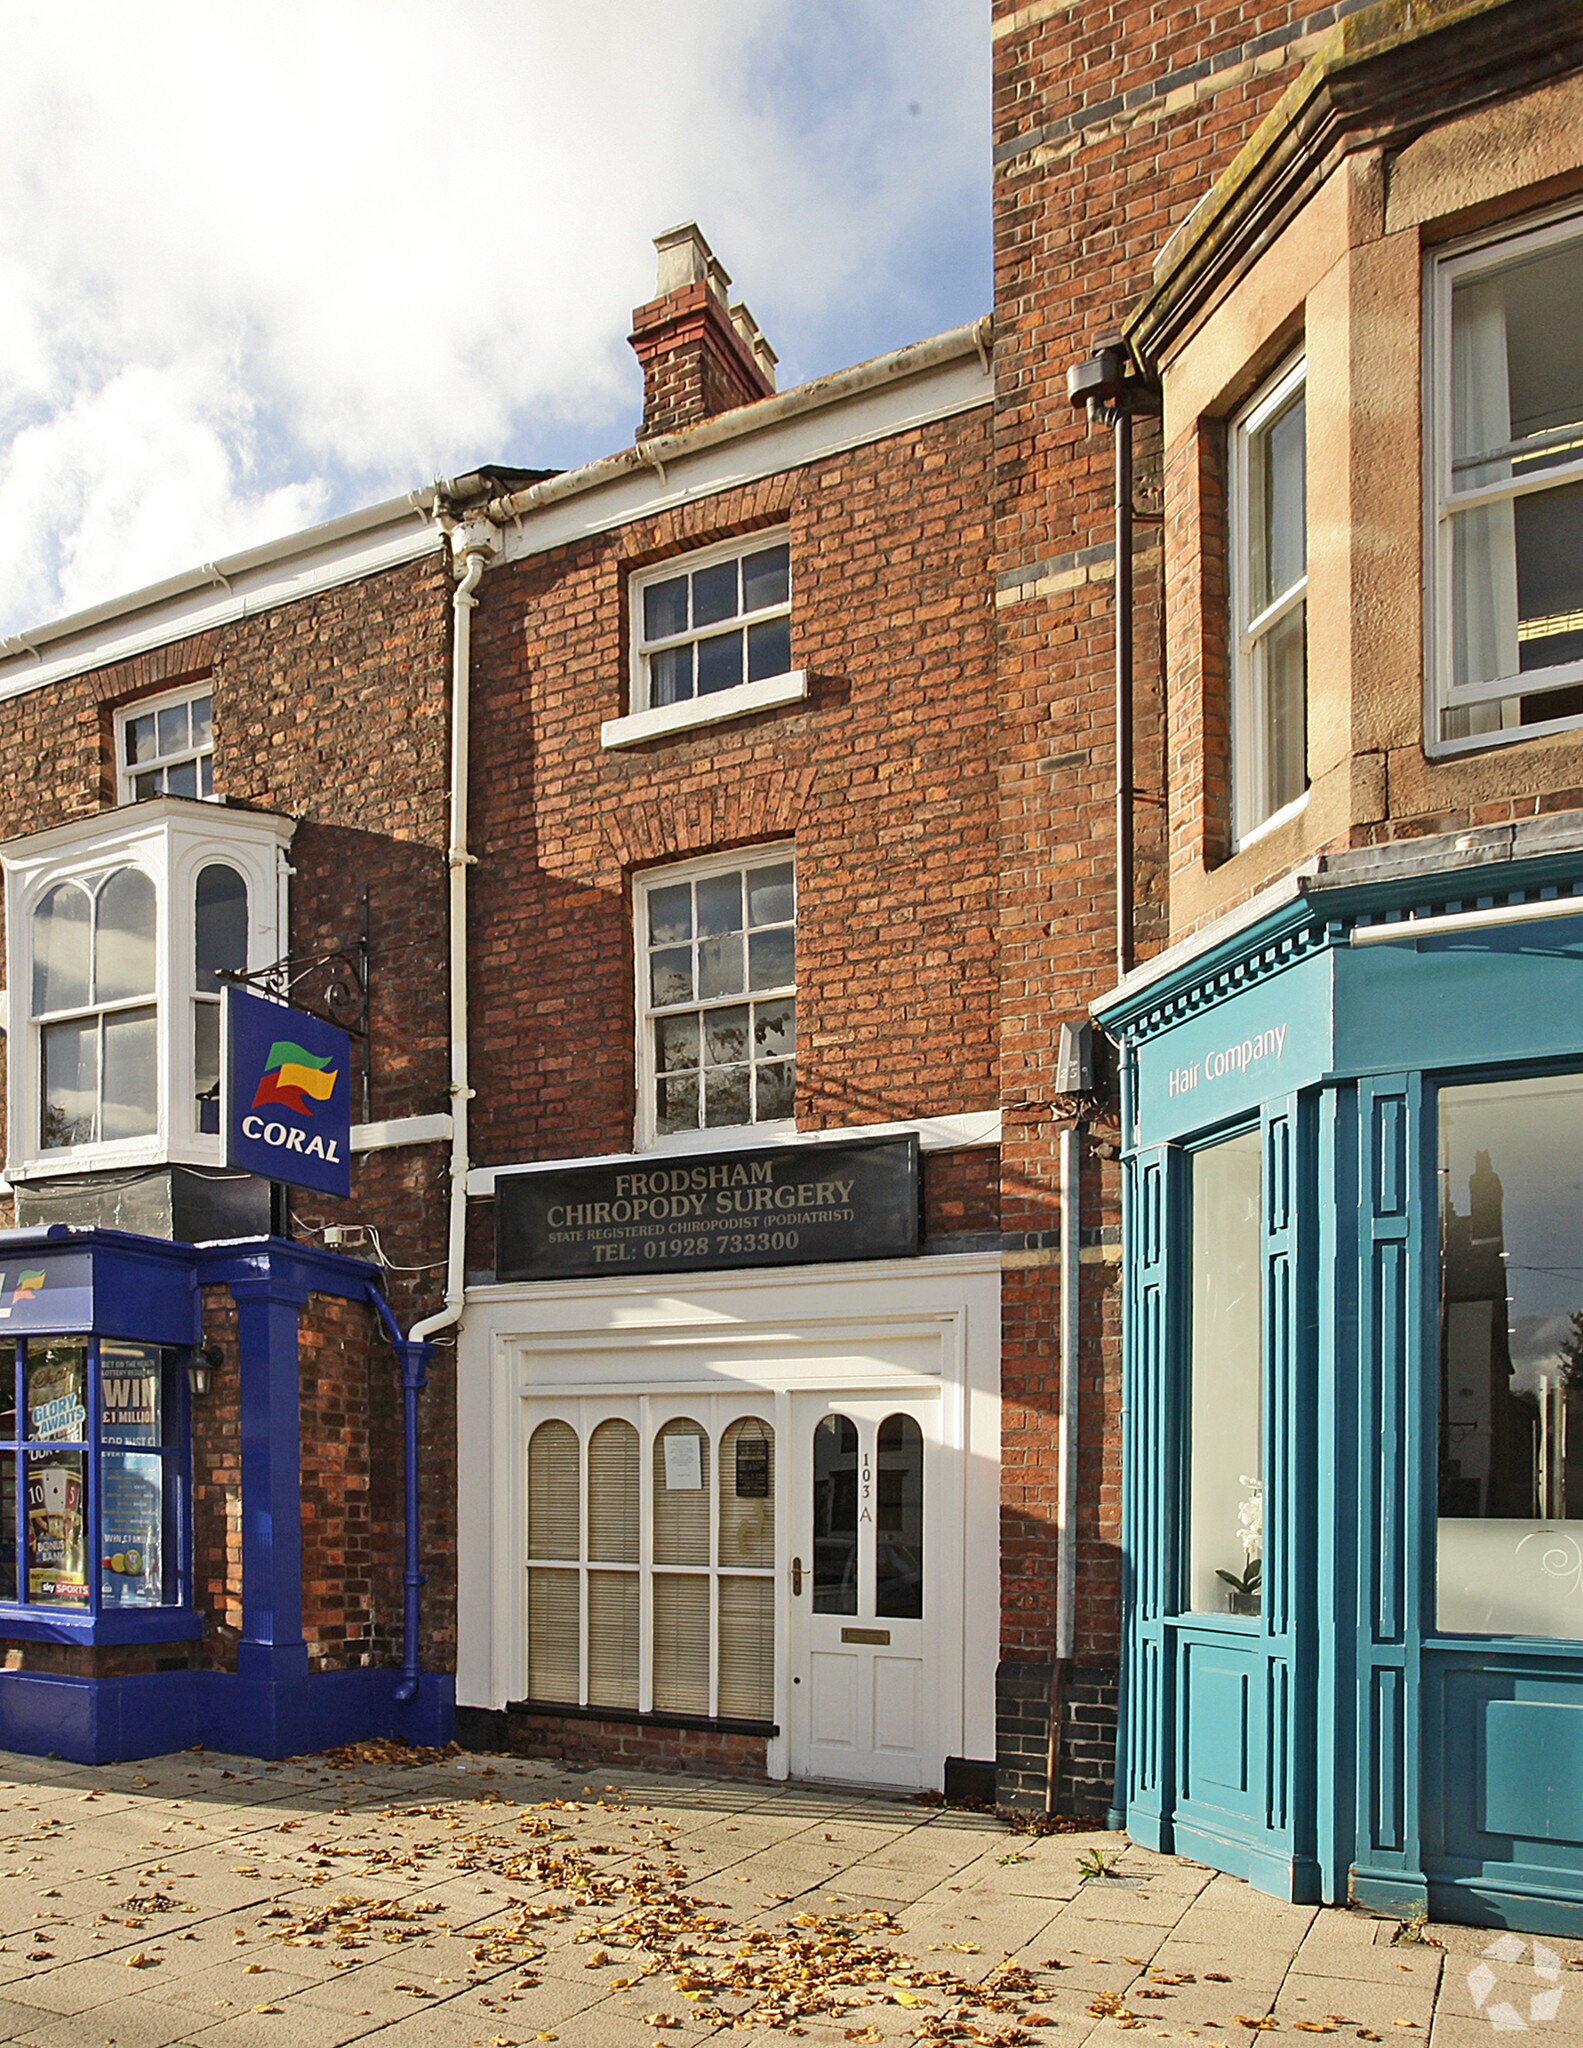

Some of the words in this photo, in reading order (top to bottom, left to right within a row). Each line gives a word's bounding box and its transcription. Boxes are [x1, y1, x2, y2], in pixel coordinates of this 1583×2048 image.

[1169, 1060, 1201, 1098] Hair
[1205, 1023, 1288, 1081] Company
[241, 1115, 340, 1163] CORAL
[616, 1160, 774, 1197] FRODSHAM
[547, 1193, 707, 1228] CHIROPODY
[716, 1179, 855, 1214] SURGERY
[549, 1230, 584, 1244] STATE
[587, 1223, 665, 1241] REGISTERED
[668, 1216, 760, 1235] CHIROPODIST
[763, 1208, 855, 1229] (PODIATRIST)
[592, 1243, 637, 1263] TEL:
[644, 1237, 709, 1260] 01928
[716, 1230, 800, 1255] 733300
[33, 1393, 76, 1423] GLORY
[102, 1377, 155, 1408] WIN
[40, 1406, 84, 1434] AWAITS
[102, 1410, 116, 1424] £1
[29, 1485, 44, 1504] 10
[42, 1582, 55, 1594] sky
[55, 1584, 89, 1595] SPORTS
